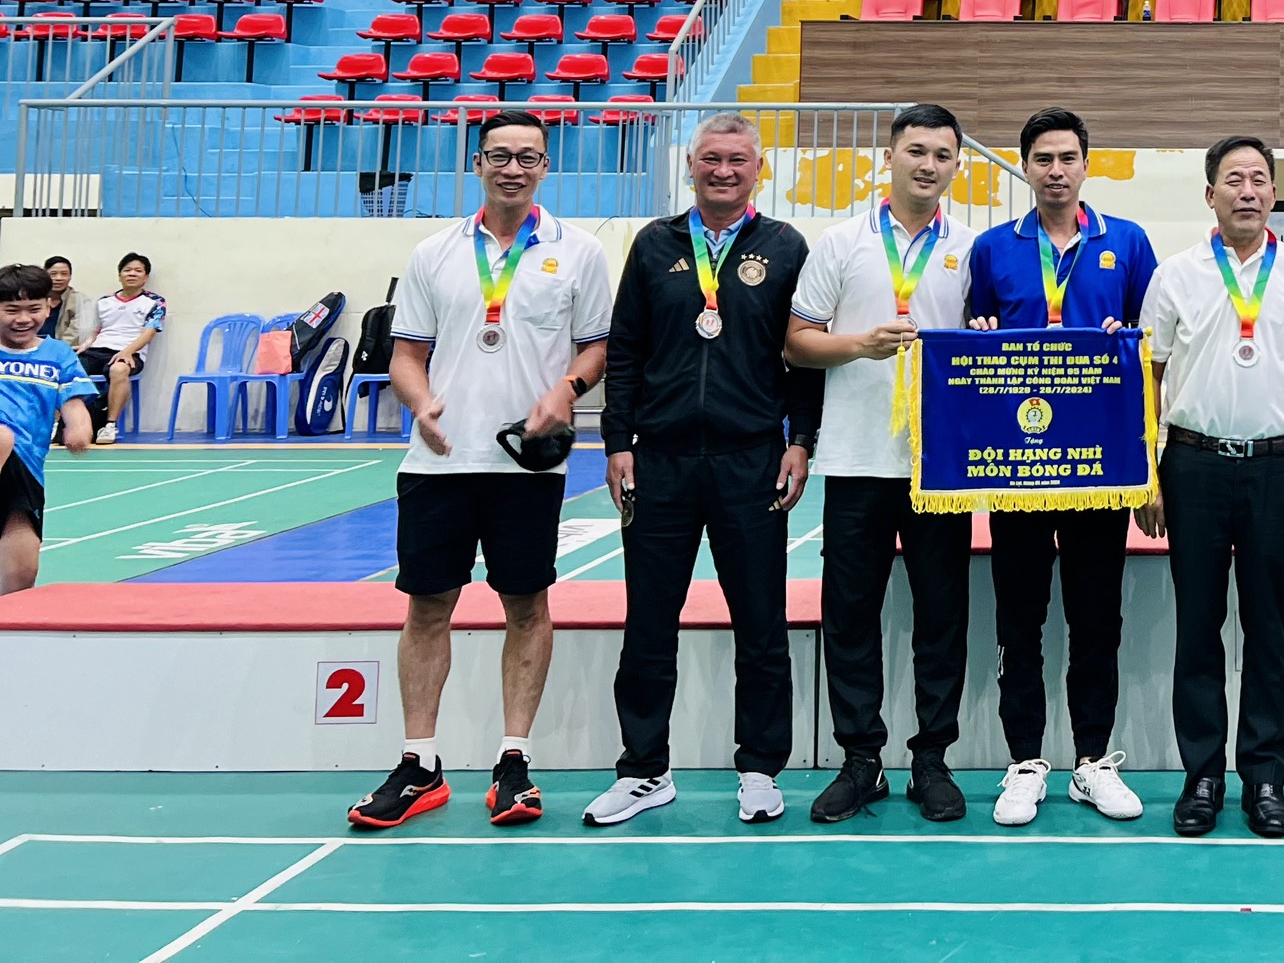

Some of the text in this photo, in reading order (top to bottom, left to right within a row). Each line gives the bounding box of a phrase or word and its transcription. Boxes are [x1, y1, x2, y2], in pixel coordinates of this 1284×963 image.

[969, 445, 1102, 463] ĐỘI HẠNG NHÌ
[967, 461, 1103, 477] MÔN BÓNG ĐÁ
[323, 668, 365, 718] 2
